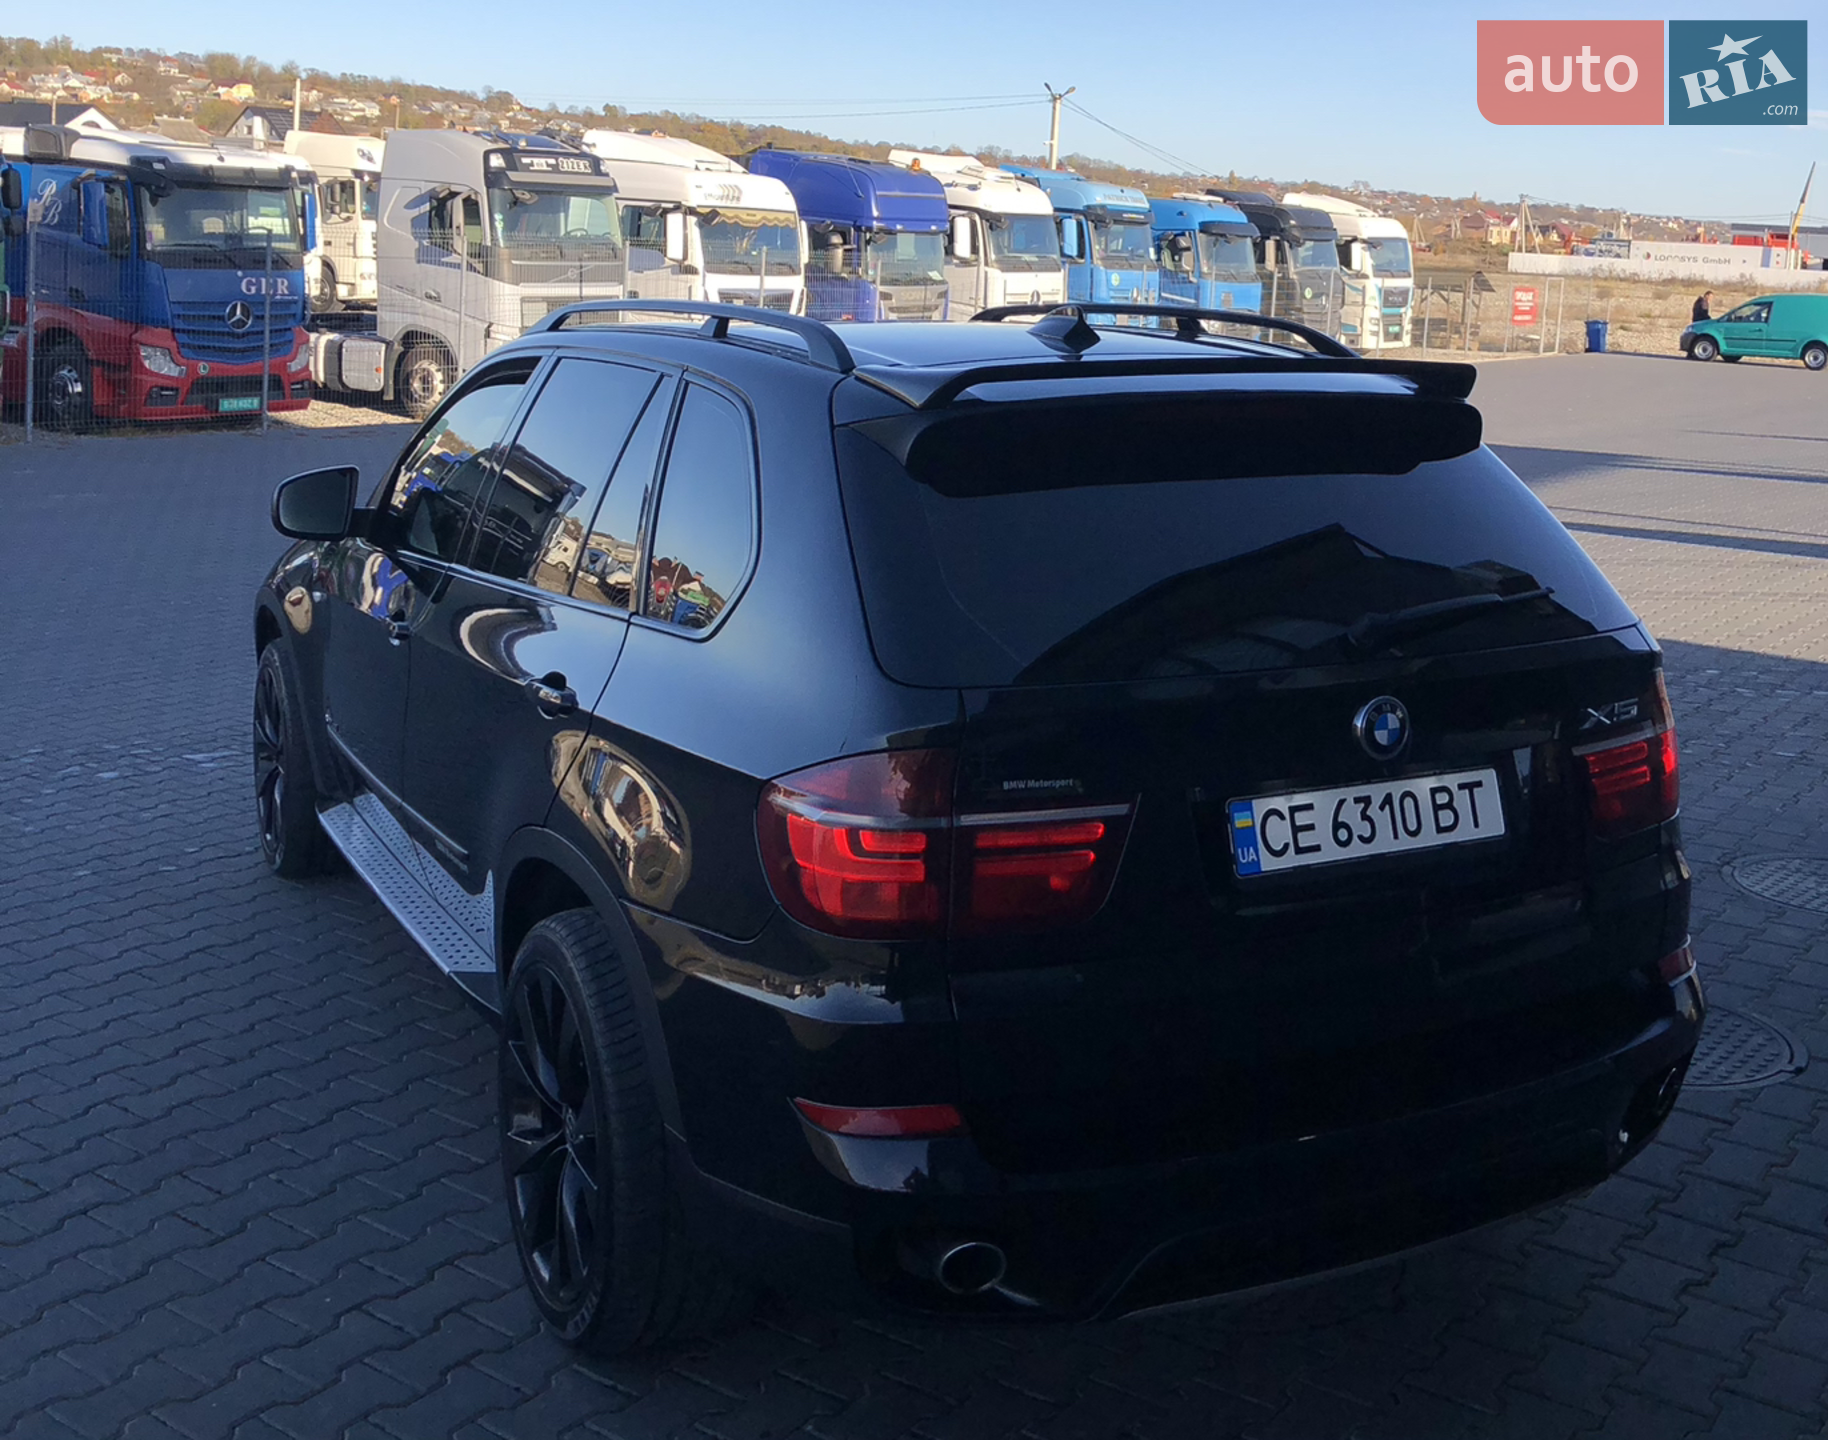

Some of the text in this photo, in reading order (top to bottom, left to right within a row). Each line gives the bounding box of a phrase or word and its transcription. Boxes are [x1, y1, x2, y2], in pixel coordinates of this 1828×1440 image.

[1702, 256, 1731, 265] GmbH
[1579, 698, 1639, 730] X5
[1003, 779, 1073, 790] BMW Motorsport
[1259, 780, 1484, 858] CE 6310 BT
[1238, 846, 1258, 864] UA
